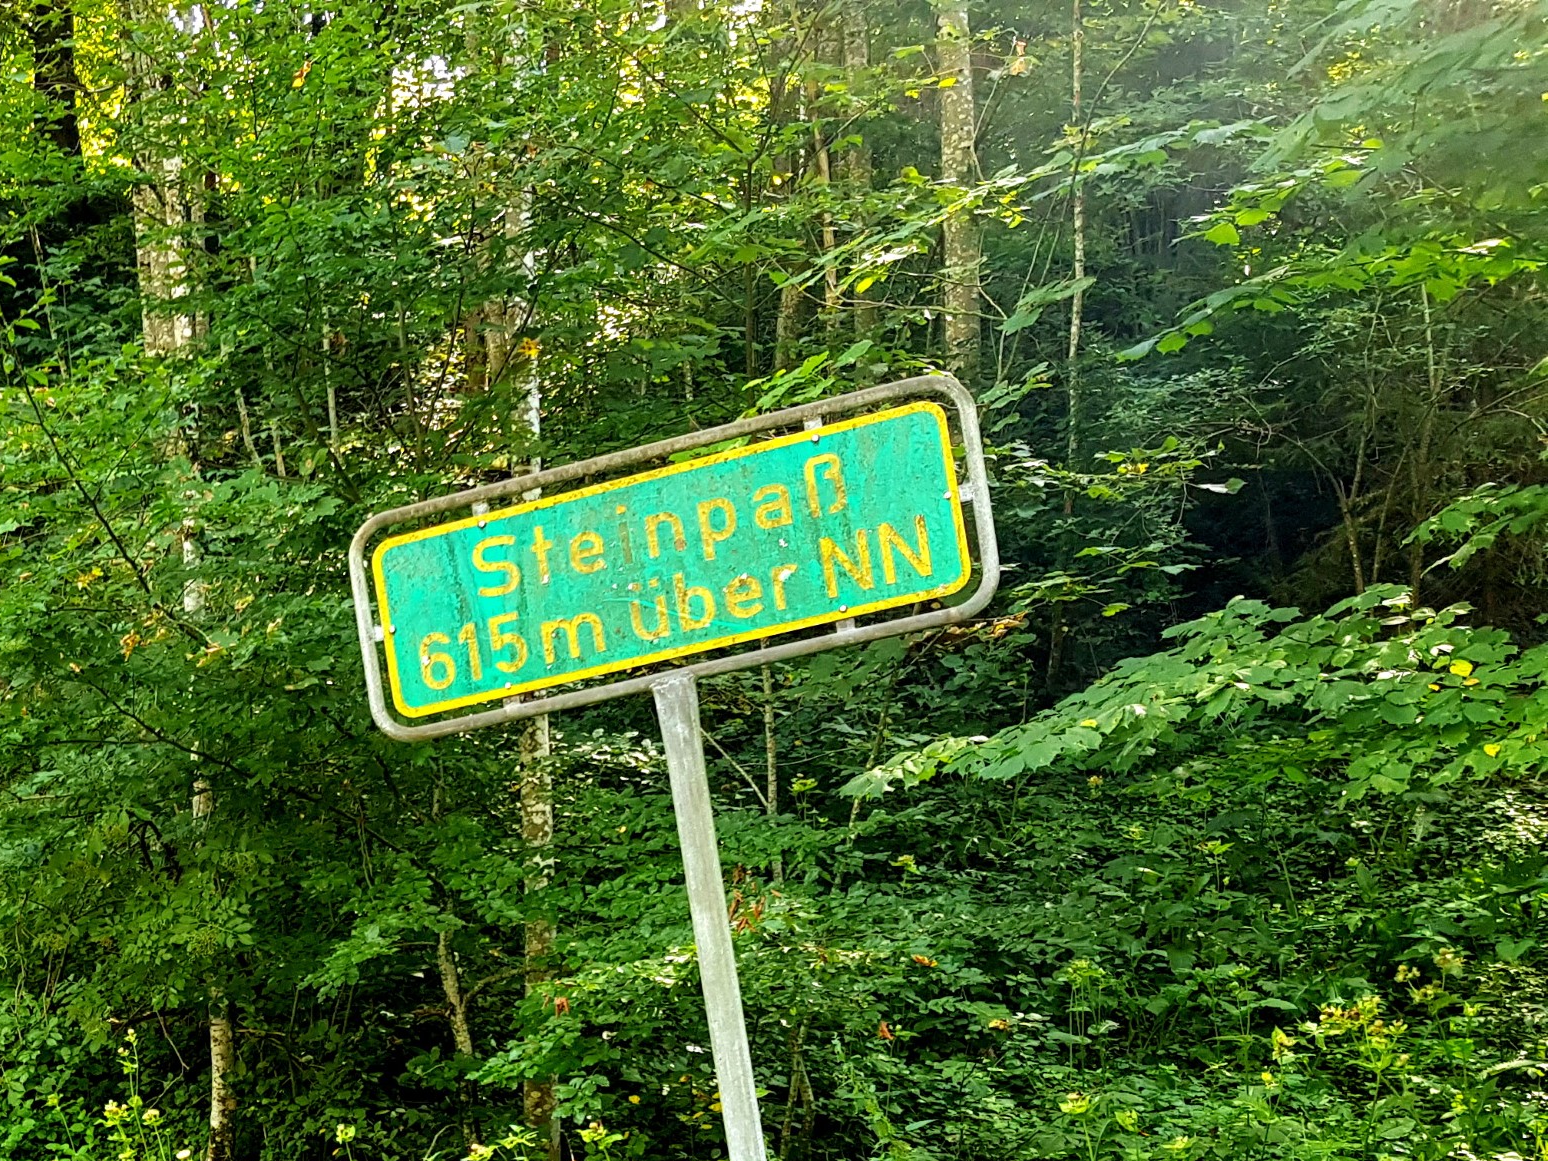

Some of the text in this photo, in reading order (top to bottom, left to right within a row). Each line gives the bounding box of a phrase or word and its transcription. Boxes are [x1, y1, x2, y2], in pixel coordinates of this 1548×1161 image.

[472, 453, 848, 598] Steinpaß
[628, 564, 798, 641] über
[818, 514, 933, 600] NN
